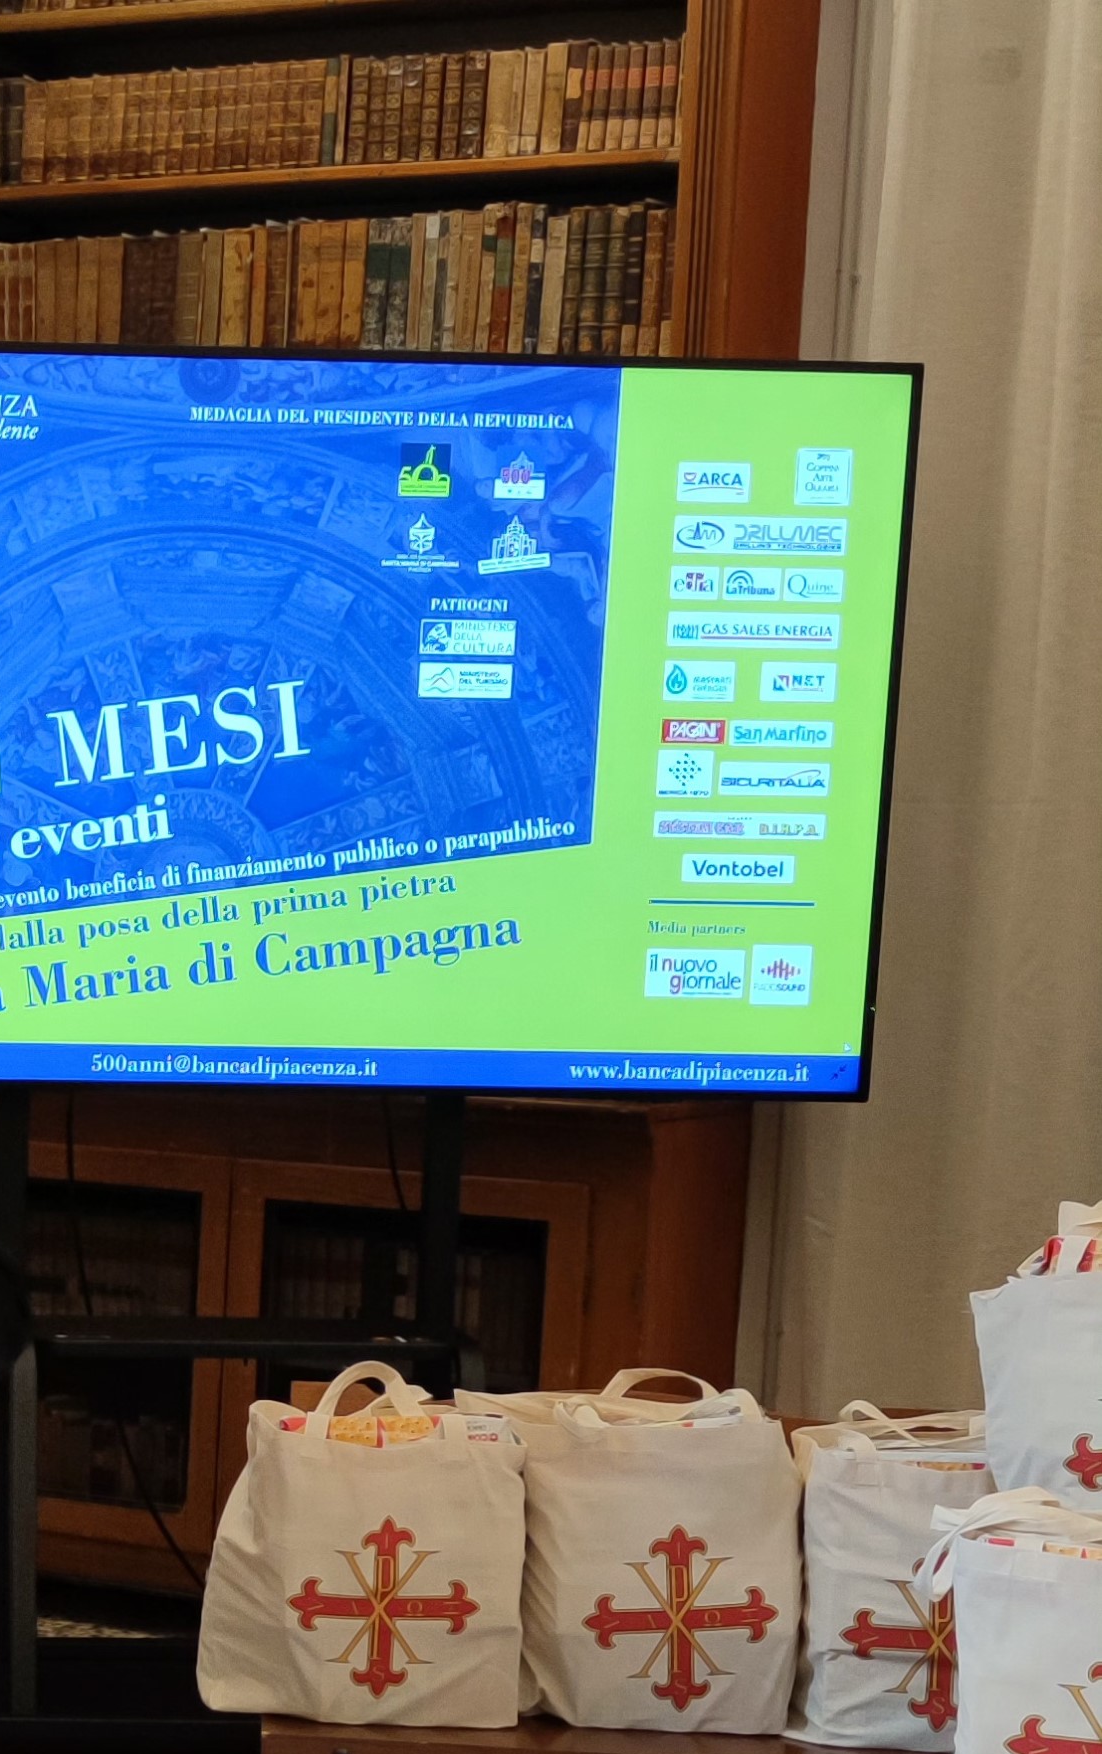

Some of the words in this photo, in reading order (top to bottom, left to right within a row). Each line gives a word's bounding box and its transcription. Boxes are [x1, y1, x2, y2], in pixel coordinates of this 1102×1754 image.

[189, 406, 273, 424] MEDAGLIA
[277, 408, 310, 425] DEL
[313, 409, 414, 428] PRESIDENTE
[417, 411, 470, 428] DELLA
[473, 412, 575, 431] REPUBBLICA
[698, 471, 743, 487] ARCA
[734, 523, 843, 542] DRILLMEC
[430, 597, 509, 612] PATROCINI
[454, 622, 516, 632] MINISTERO
[454, 632, 482, 641] DELLA
[701, 623, 729, 635] GAS
[731, 624, 771, 636] SALES
[775, 625, 833, 637] ENERGIA
[453, 642, 513, 653] CULTURA
[45, 679, 312, 788] MESI
[10, 794, 176, 860] eventi
[66, 874, 156, 900] beneficia
[161, 864, 183, 889] di
[186, 849, 327, 887] finanziamento
[333, 838, 419, 872] pubblico
[425, 839, 438, 855] o
[445, 818, 576, 859] parapubblico
[691, 859, 784, 878] Vontobel
[77, 912, 150, 949] posa
[162, 896, 241, 930] della
[251, 887, 348, 926] prima
[358, 874, 458, 912] pietra
[647, 920, 687, 934] Media
[691, 924, 746, 937] partners
[20, 954, 173, 1009] Maria
[188, 941, 238, 987] di
[254, 916, 523, 976] Campagna
[649, 953, 659, 972] il
[662, 957, 718, 973] nuovo
[669, 971, 742, 995] giornale
[90, 1052, 379, 1081] 500anni@bancadipiacenza.it
[569, 1059, 810, 1086] www.bancadipiacenza.it
